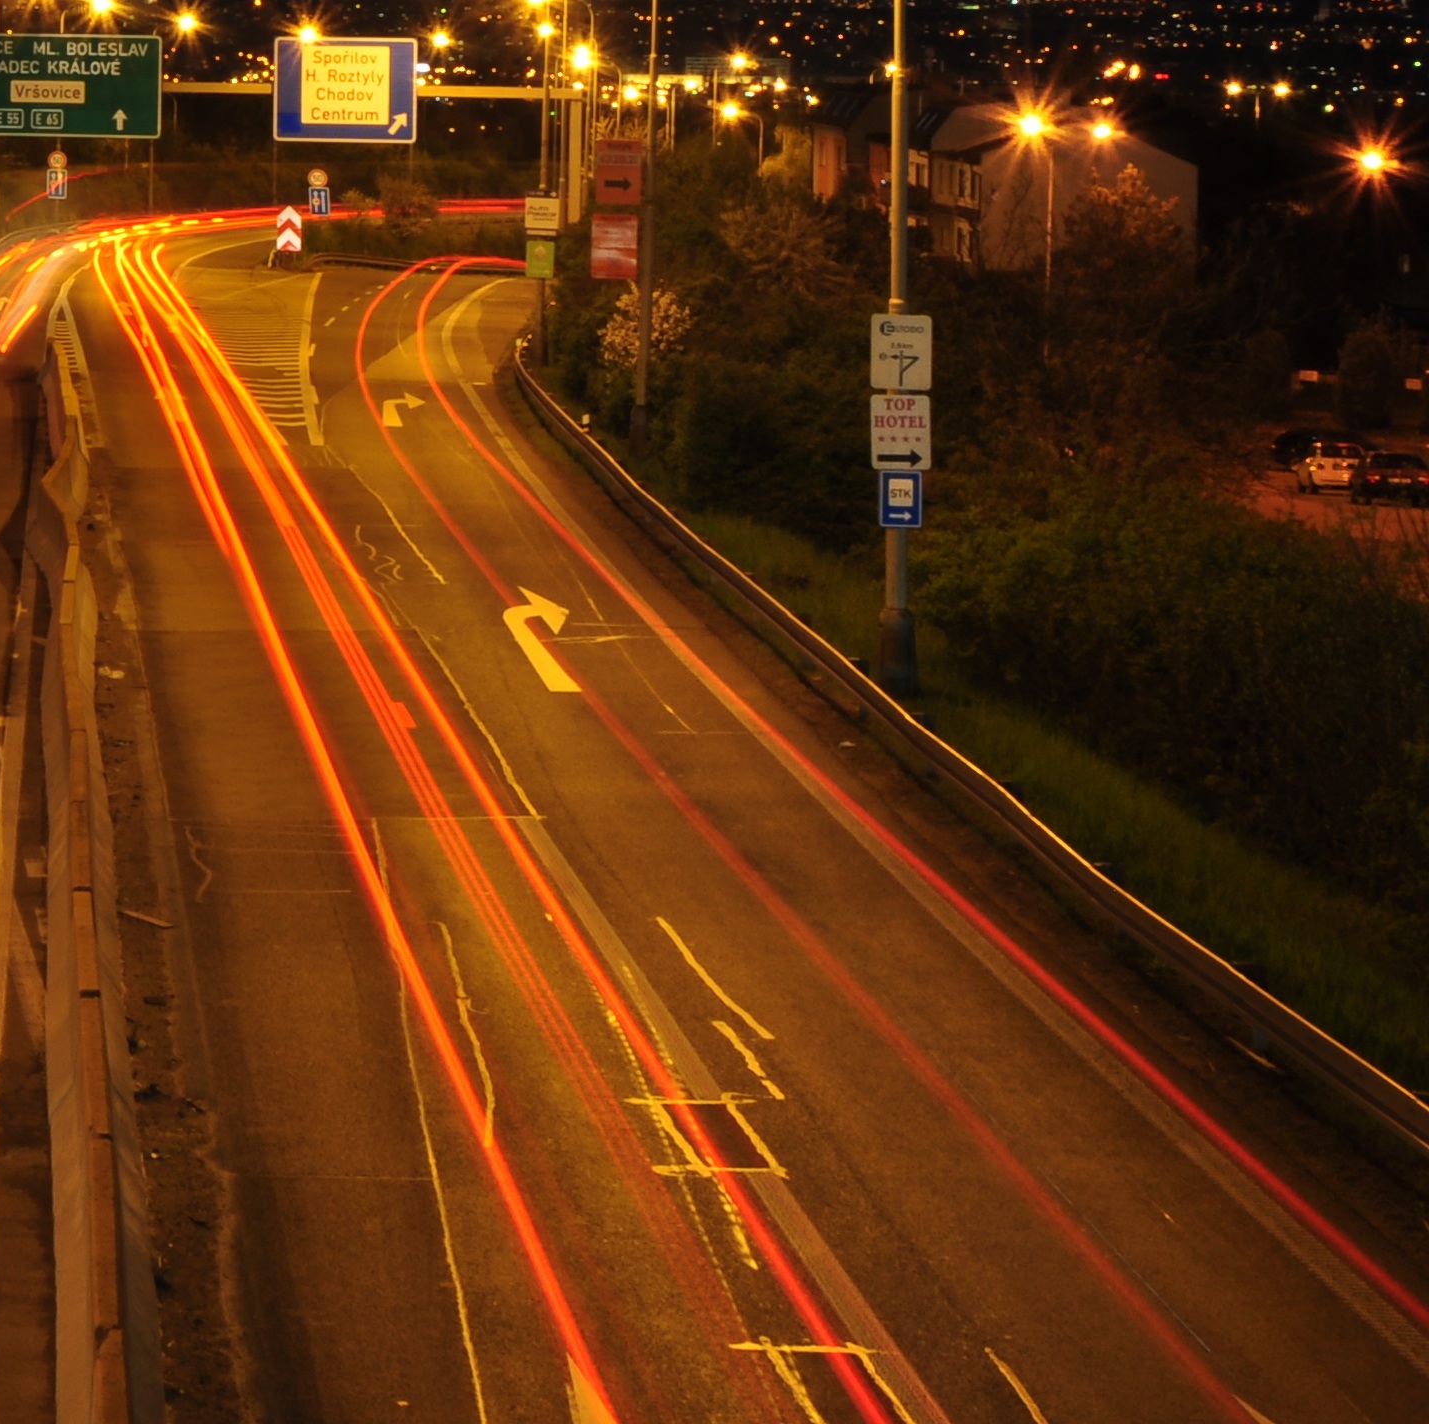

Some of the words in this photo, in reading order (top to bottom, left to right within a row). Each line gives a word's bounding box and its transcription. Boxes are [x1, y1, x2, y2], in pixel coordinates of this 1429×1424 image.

[33, 42, 60, 56] ML.
[66, 42, 149, 57] BOLESLAV
[313, 49, 378, 67] Spořilov
[47, 58, 122, 76] KRÁLOVÉ
[305, 69, 320, 82] H.
[327, 69, 385, 86] Roztyly
[14, 84, 81, 100] Vršovice
[316, 87, 374, 102] Chodov
[6, 112, 20, 125] 55
[35, 112, 42, 125] E
[46, 112, 59, 125] 65
[311, 107, 379, 122] Centrum
[52, 156, 63, 165] 50
[884, 398, 916, 411] TOP
[874, 415, 927, 429] HOTEL
[890, 488, 912, 499] STK
